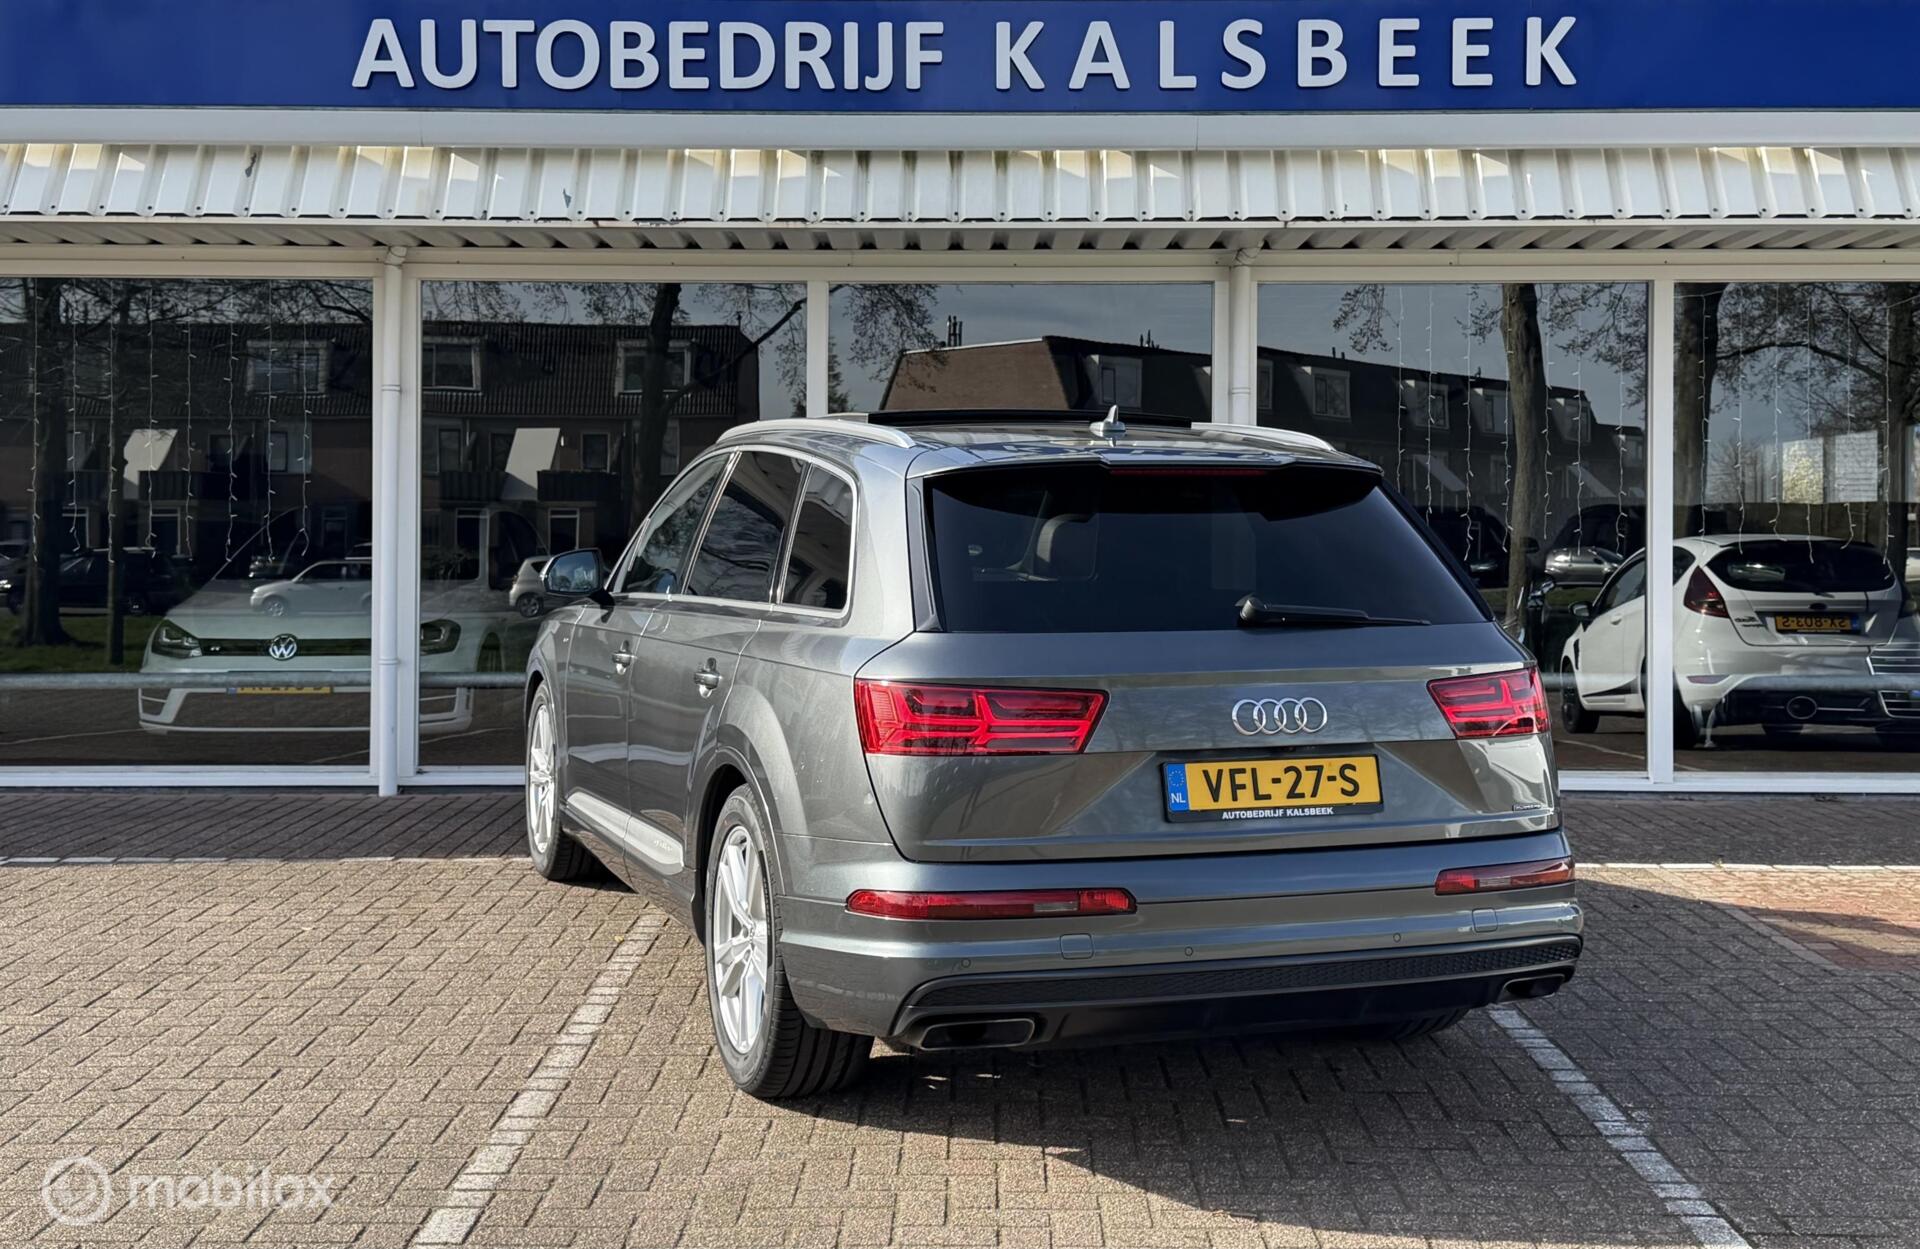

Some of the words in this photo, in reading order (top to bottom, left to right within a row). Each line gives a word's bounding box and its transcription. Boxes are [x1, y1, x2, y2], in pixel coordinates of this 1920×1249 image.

[351, 18, 945, 91] AUTOBEDRIJF
[995, 16, 1578, 90] KALSBEEK
[1202, 763, 1361, 803] VFL-27-S
[1171, 793, 1186, 803] NL
[1221, 808, 1284, 820] AUTOBEDRIJF
[1285, 806, 1334, 817] KALSBEEK
